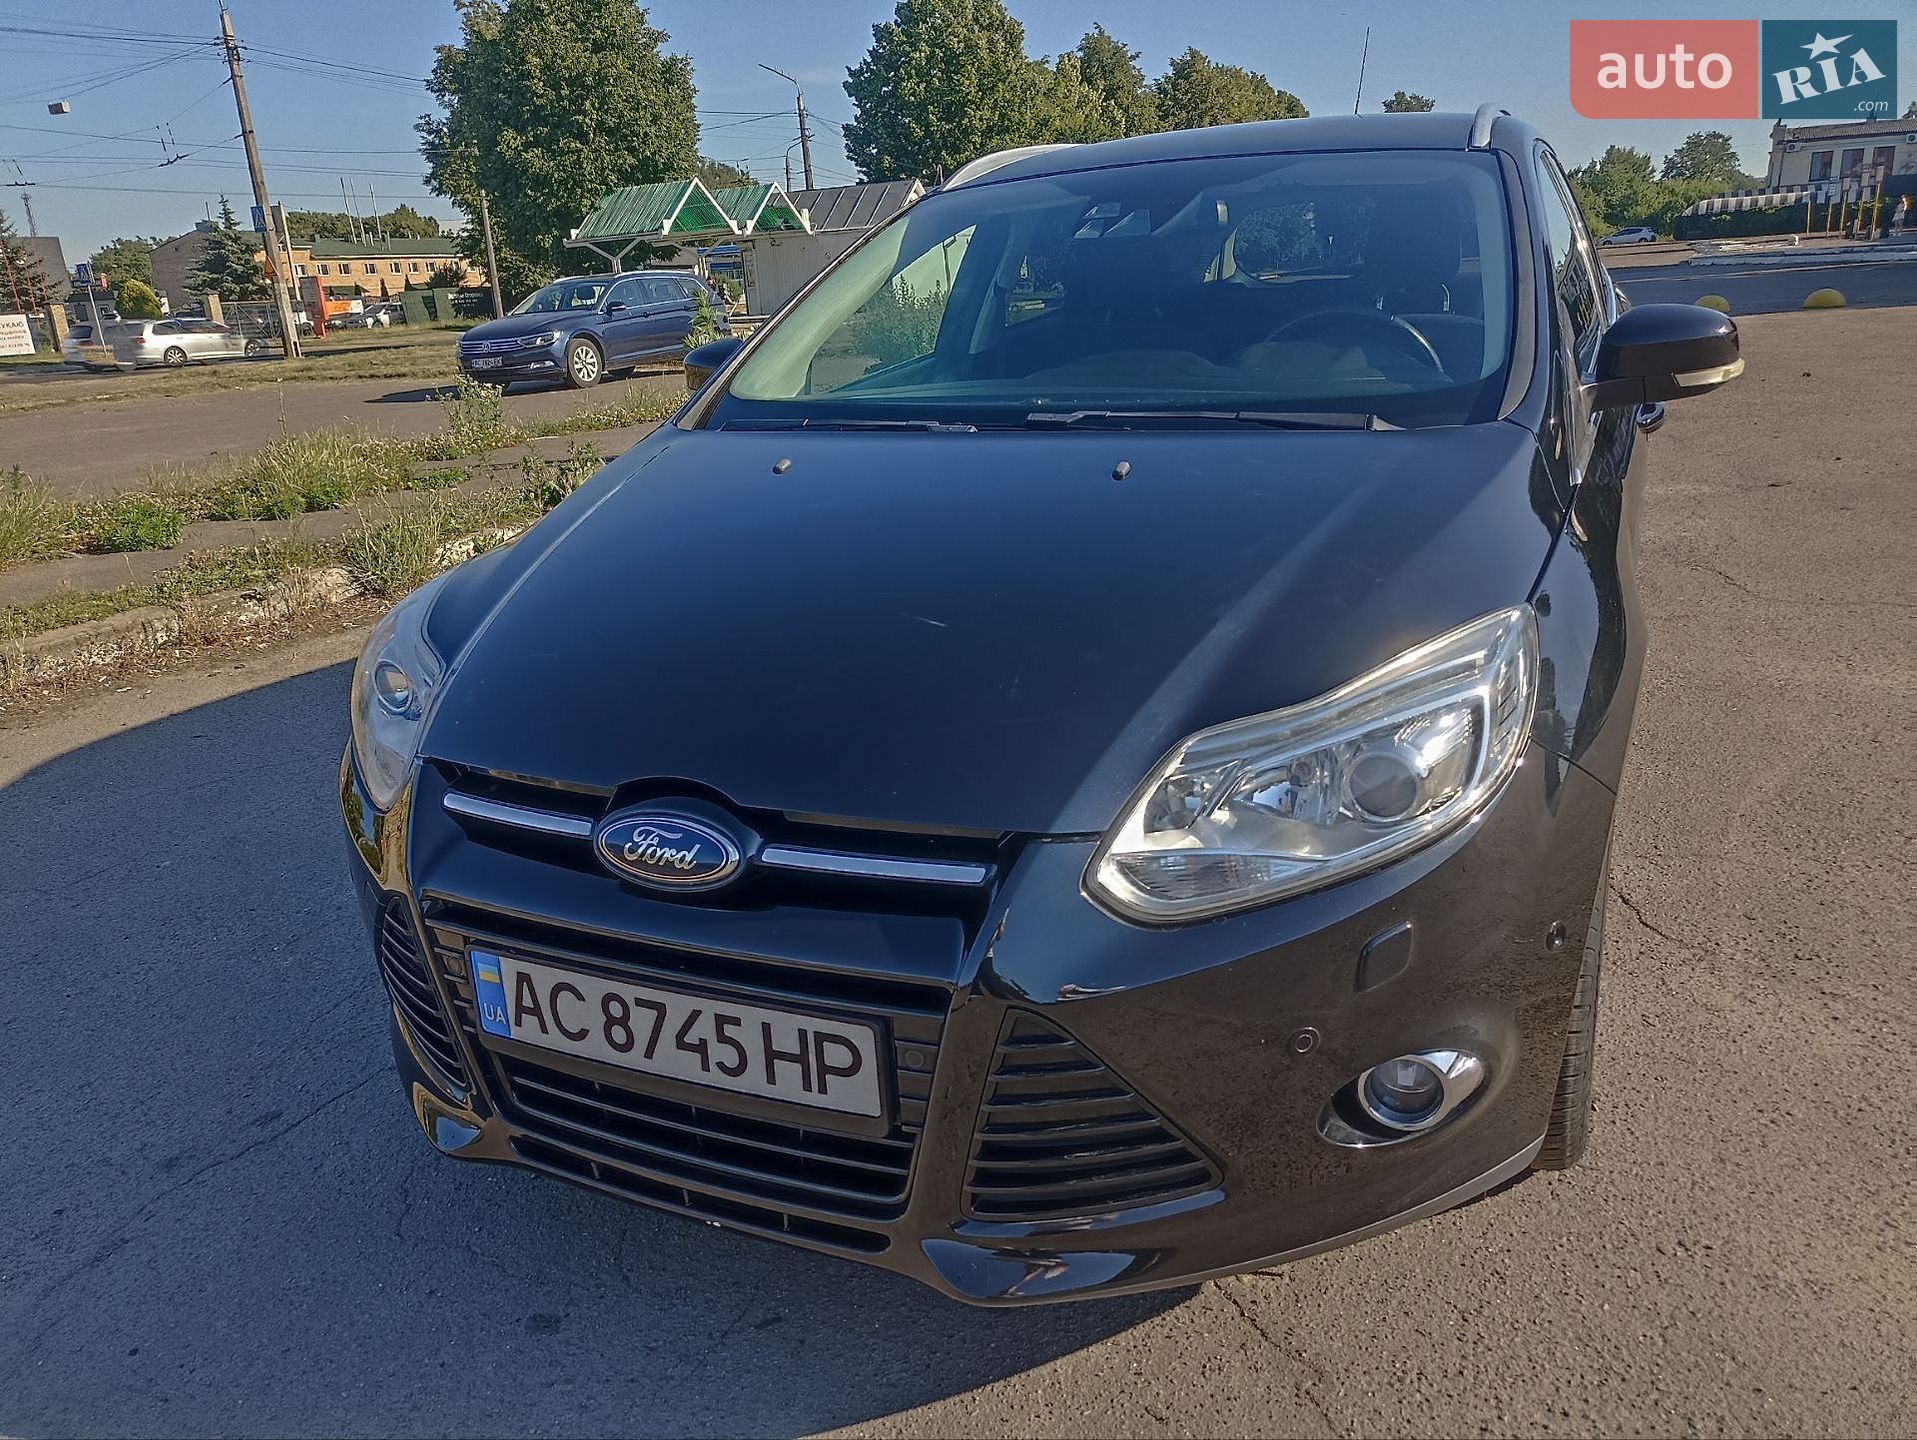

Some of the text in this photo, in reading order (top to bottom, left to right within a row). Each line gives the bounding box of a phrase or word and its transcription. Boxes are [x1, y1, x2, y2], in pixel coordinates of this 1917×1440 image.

[623, 826, 701, 871] Ford
[484, 1002, 507, 1026] UA
[514, 971, 863, 1095] AC 8745 HP
